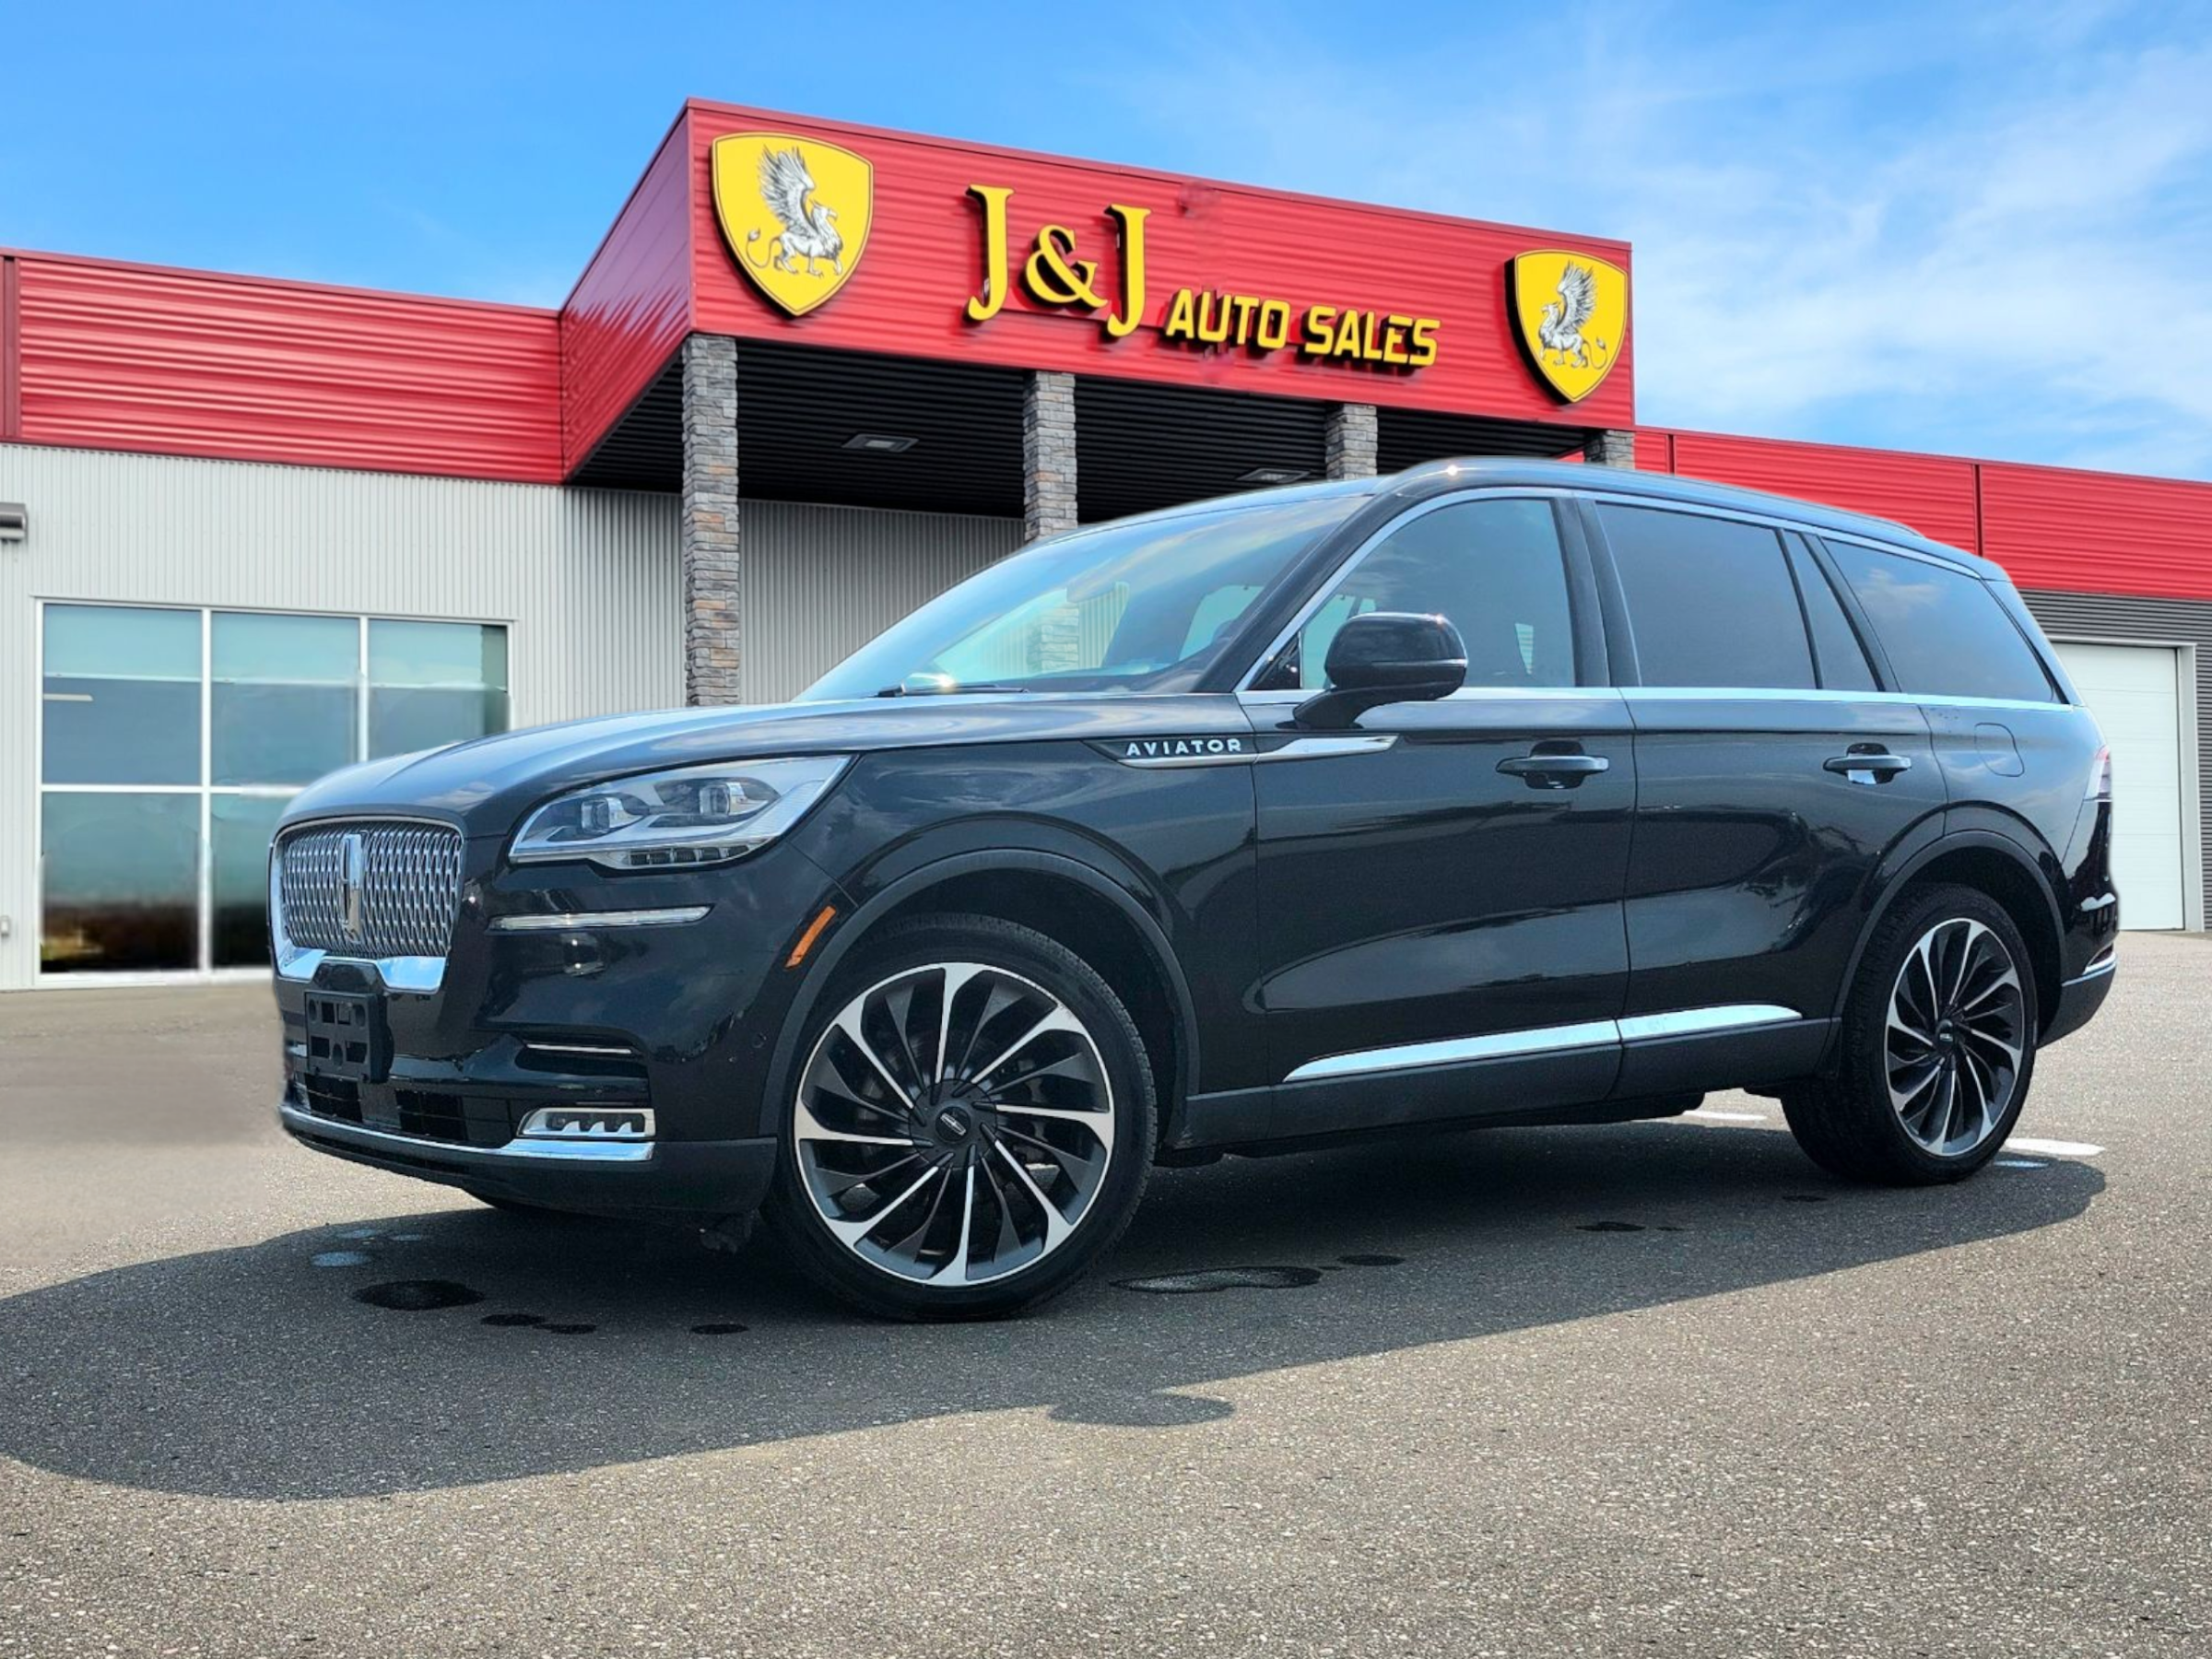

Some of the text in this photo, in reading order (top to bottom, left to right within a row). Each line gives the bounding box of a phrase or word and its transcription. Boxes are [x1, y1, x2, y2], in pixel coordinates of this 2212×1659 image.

[967, 184, 1441, 367] J&J AUTO SALES
[1125, 738, 1242, 757] AVIATOR
